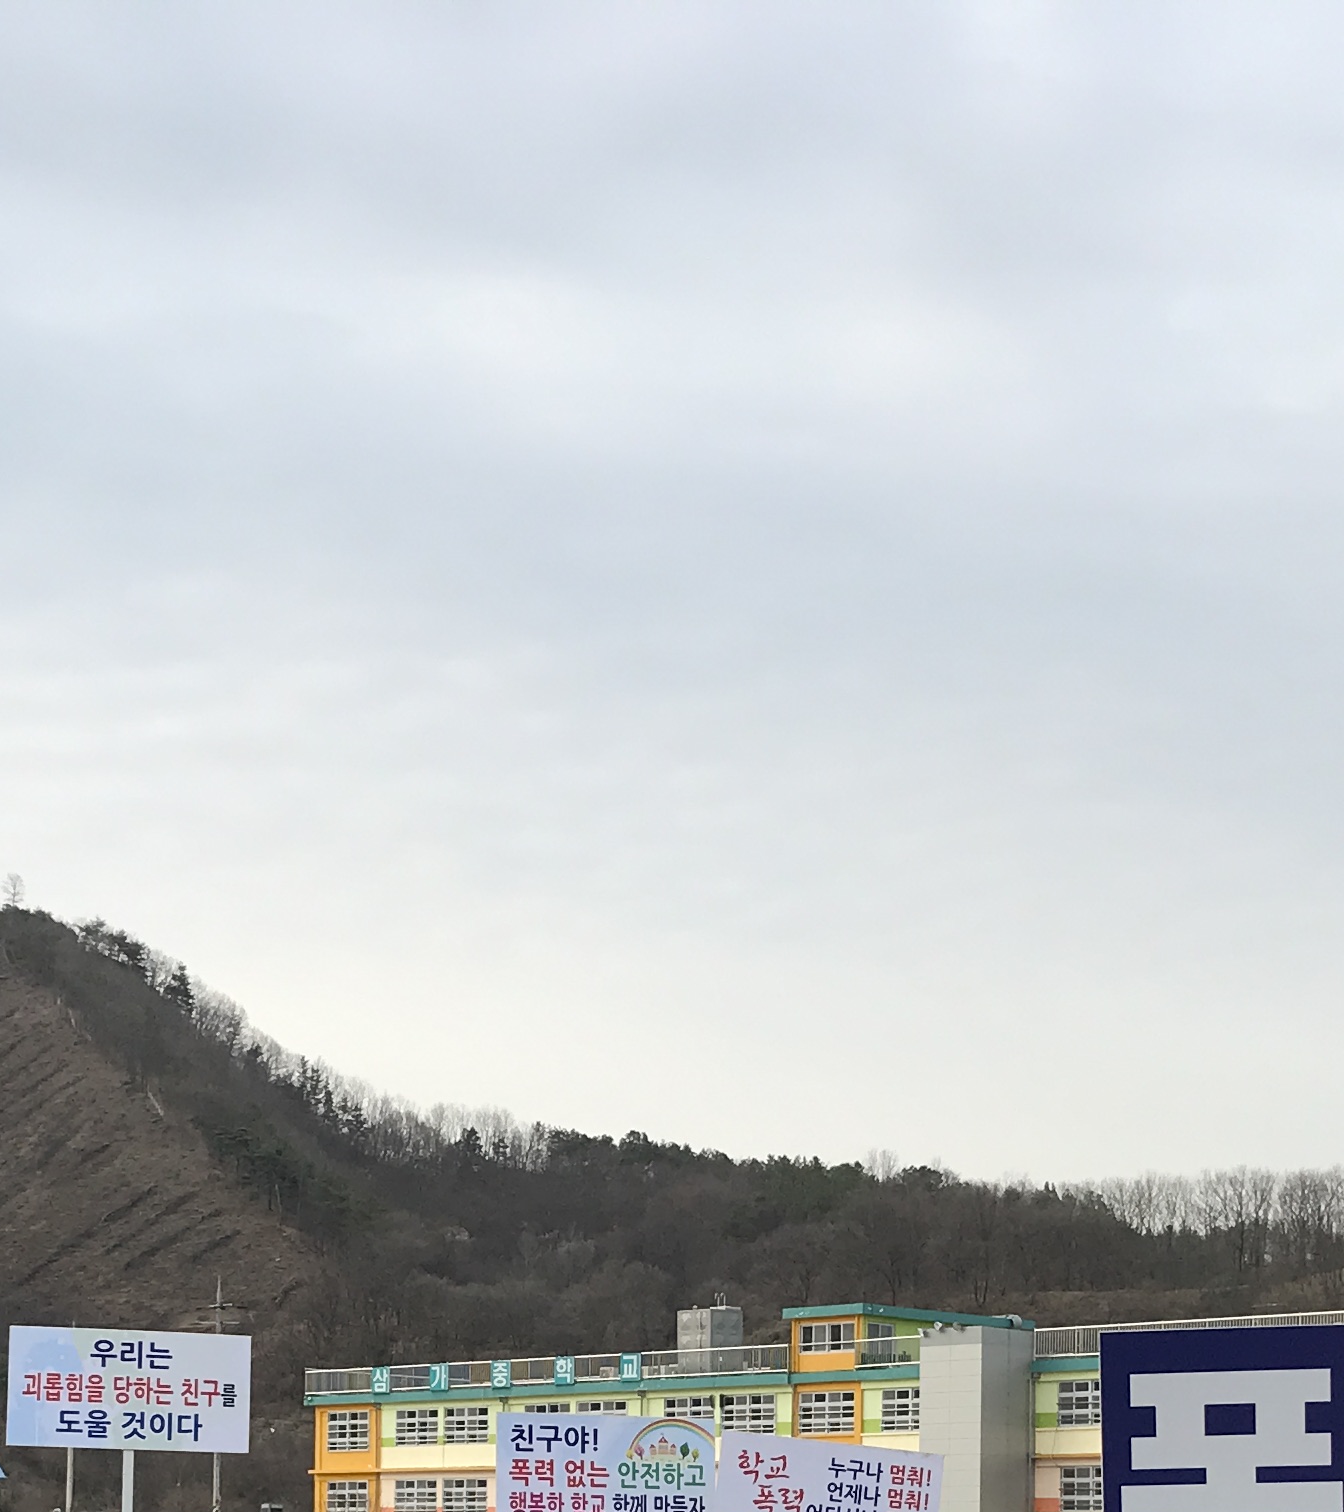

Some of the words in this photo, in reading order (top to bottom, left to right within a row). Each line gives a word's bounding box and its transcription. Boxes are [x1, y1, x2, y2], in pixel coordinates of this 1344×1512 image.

[90, 1339, 173, 1370] 우리는
[373, 1354, 639, 1393] 삼가중학교
[22, 1372, 106, 1403] 괴롭힘을
[113, 1376, 174, 1405] 당하는
[181, 1379, 237, 1408] 친구를
[55, 1410, 111, 1439] 도울
[122, 1412, 203, 1441] 것이다
[511, 1425, 599, 1455] 친구야!
[510, 1459, 555, 1489] 폭력
[565, 1460, 610, 1490] 없는
[617, 1461, 706, 1490] 안전하고
[737, 1448, 790, 1484] 학교
[827, 1458, 883, 1482] 누구나
[889, 1463, 932, 1488] 멈춰!
[827, 1481, 881, 1507] 언제나
[887, 1488, 929, 1512] 멈춰!
